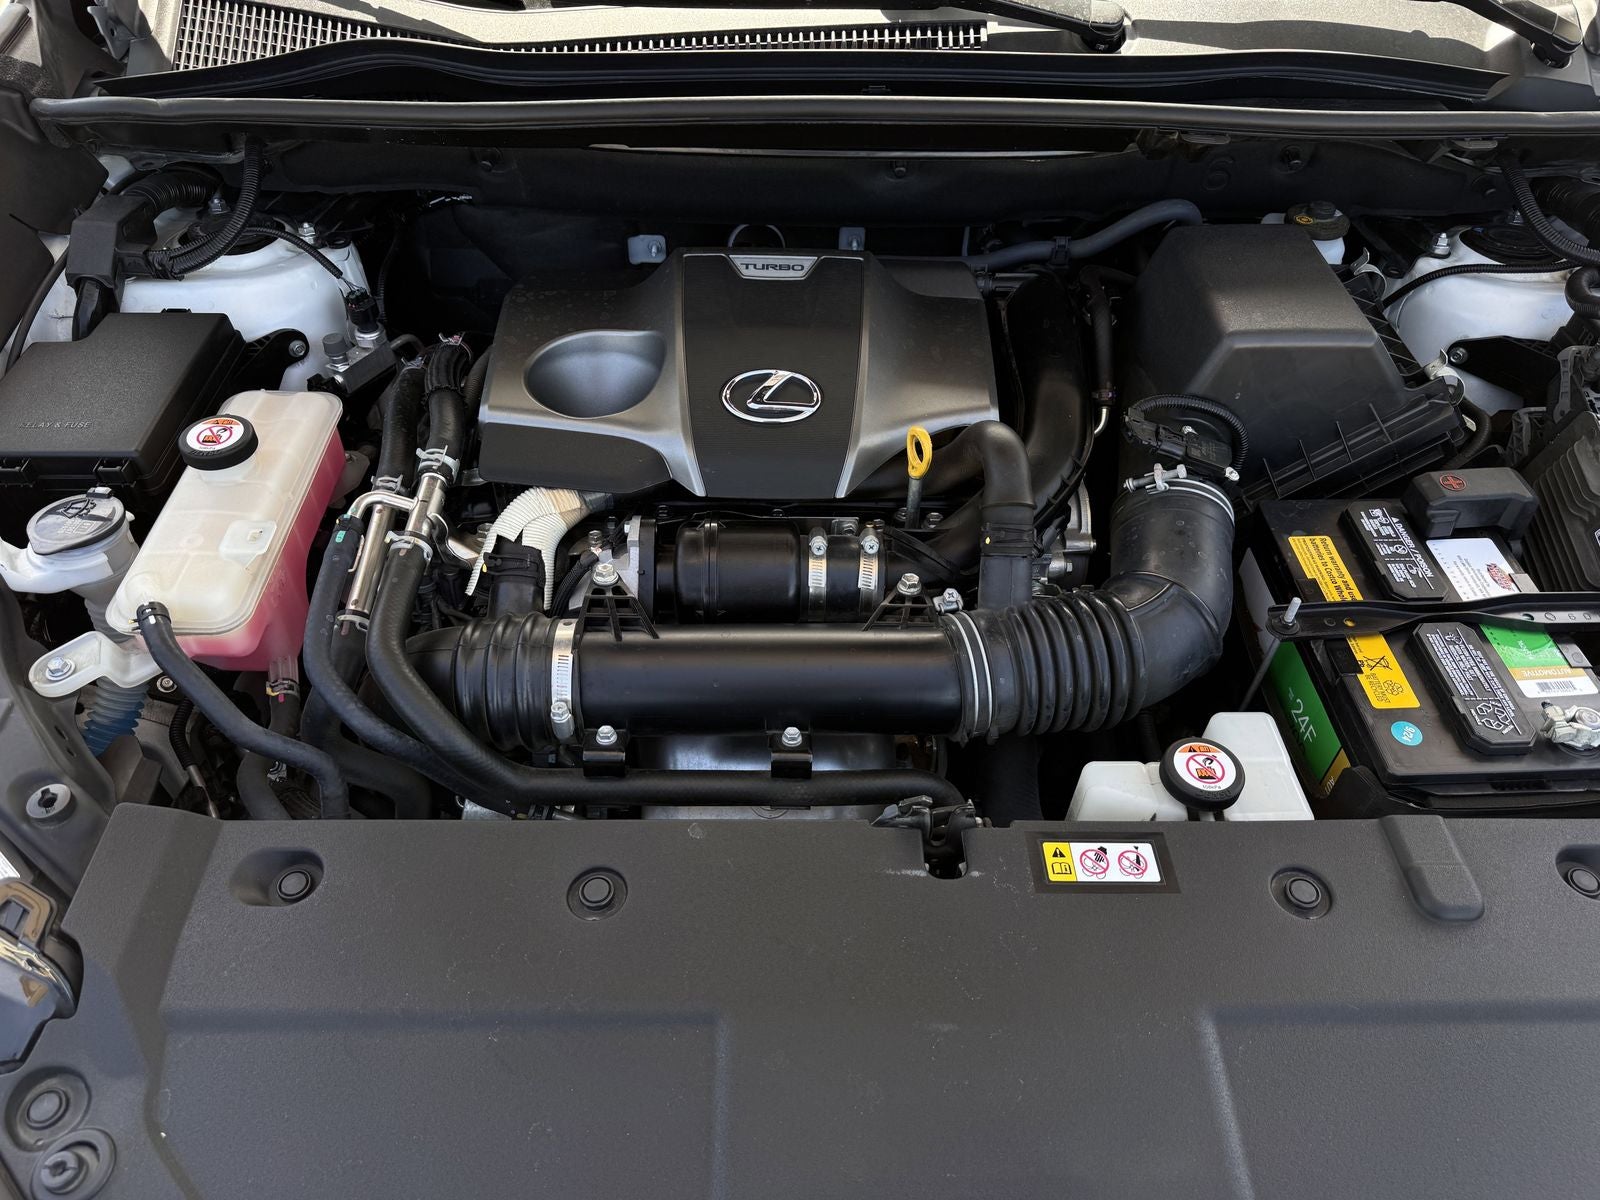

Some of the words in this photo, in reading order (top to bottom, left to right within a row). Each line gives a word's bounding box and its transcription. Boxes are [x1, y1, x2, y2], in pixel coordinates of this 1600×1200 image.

[741, 263, 804, 271] TURBO
[1395, 523, 1415, 548] DANGER
[1414, 554, 1434, 577] POISON
[1320, 537, 1332, 555] Return
[1329, 555, 1346, 579] warranty
[1342, 579, 1354, 591] and
[1348, 591, 1357, 601] use
[1325, 567, 1338, 584] Costco
[1334, 585, 1348, 601] Whol
[1521, 668, 1572, 677] AUTOMOTIVE
